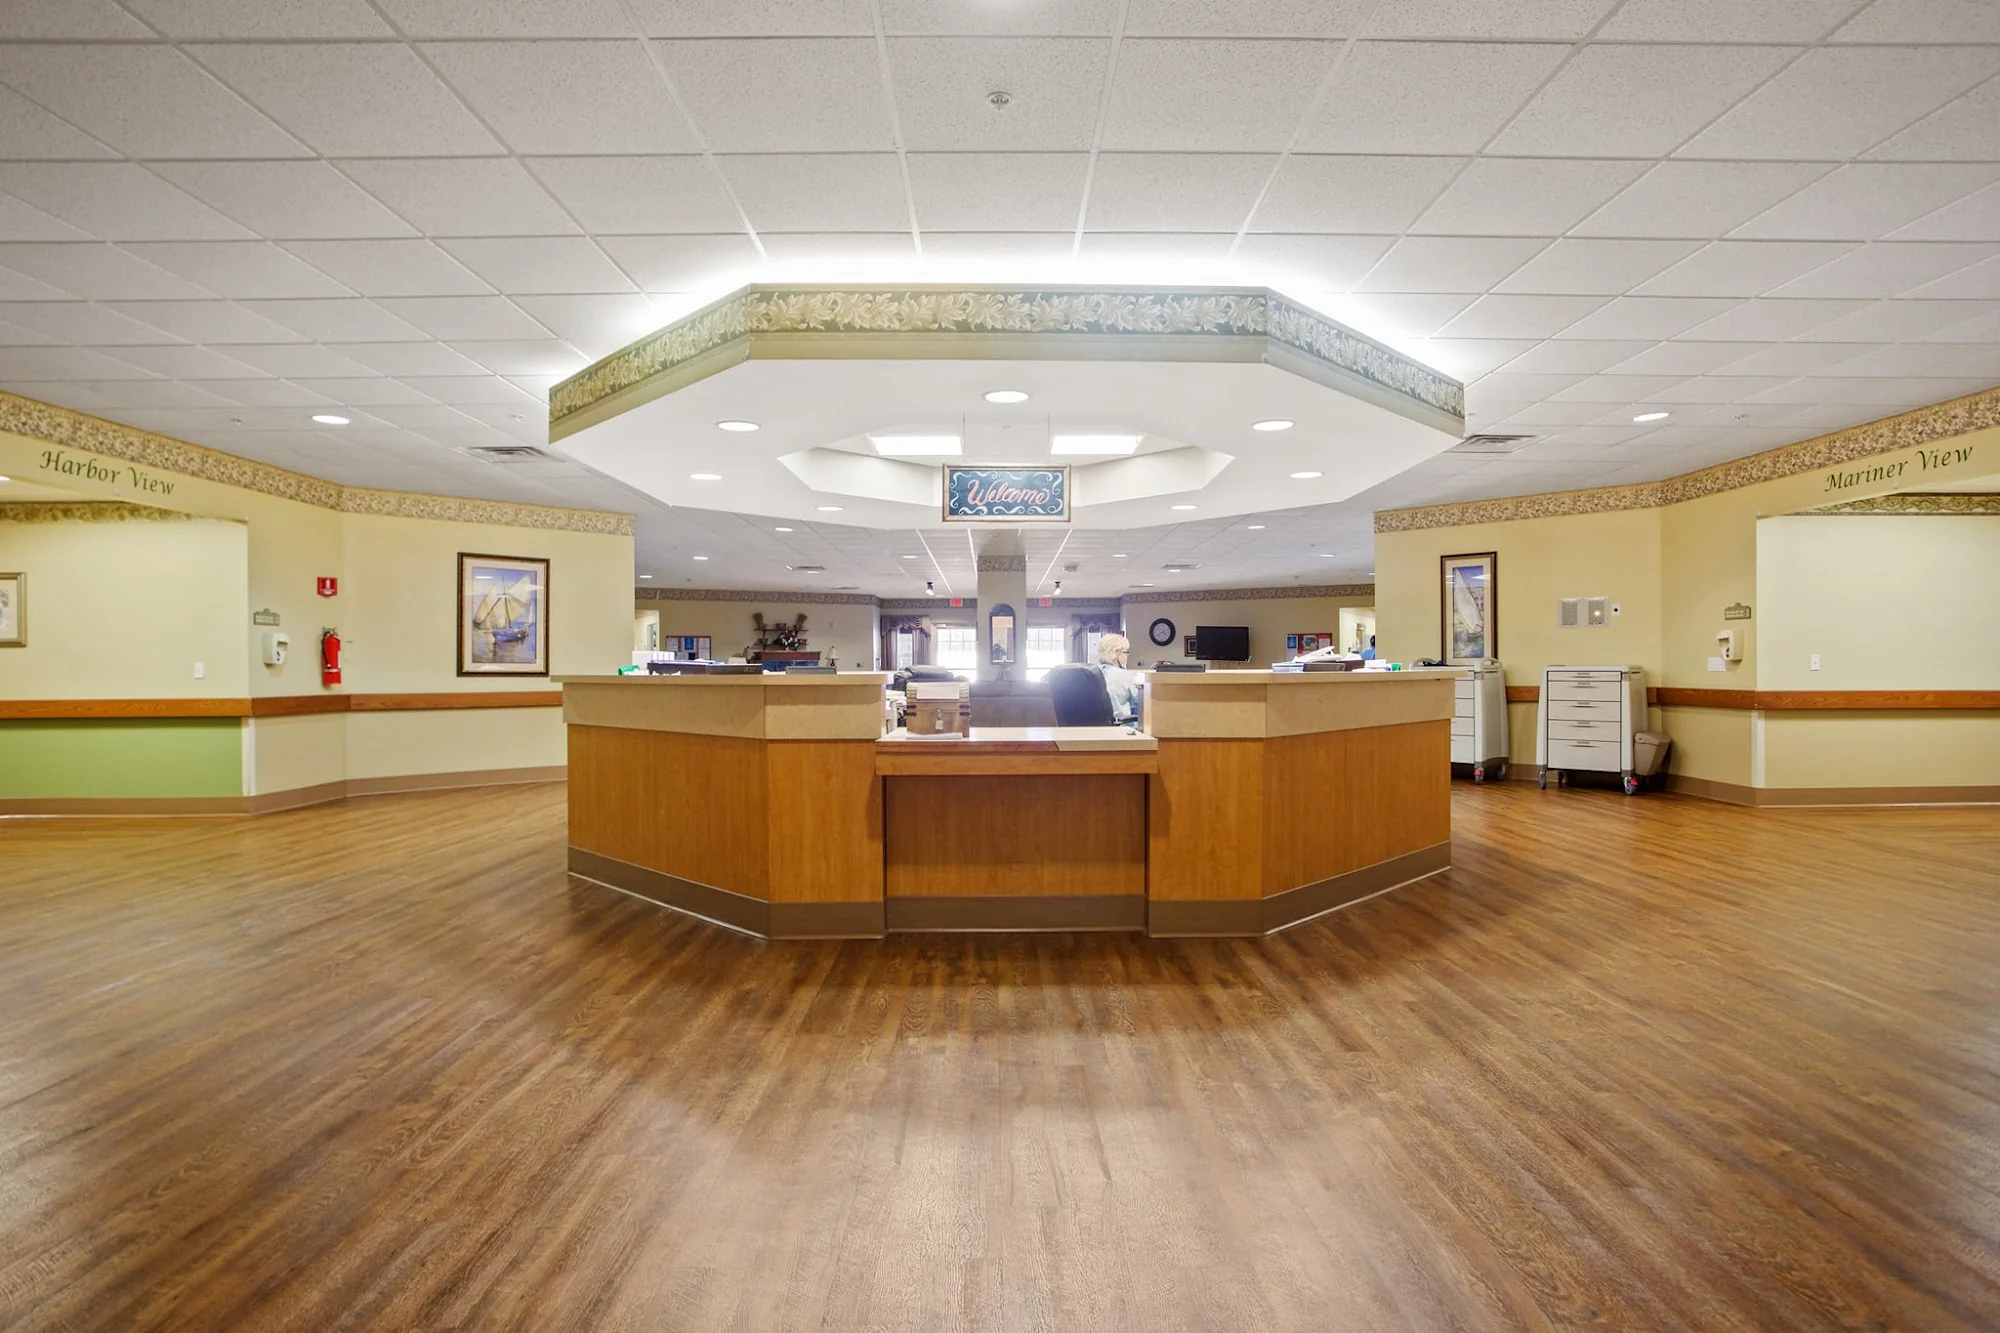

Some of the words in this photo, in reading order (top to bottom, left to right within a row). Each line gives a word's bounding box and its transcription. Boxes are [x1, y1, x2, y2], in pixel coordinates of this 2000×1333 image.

[39, 450, 121, 483] Harbor
[127, 466, 175, 495] View
[1824, 460, 1908, 492] Mariner
[1915, 446, 1973, 471] View
[967, 479, 1051, 506] Welcome
